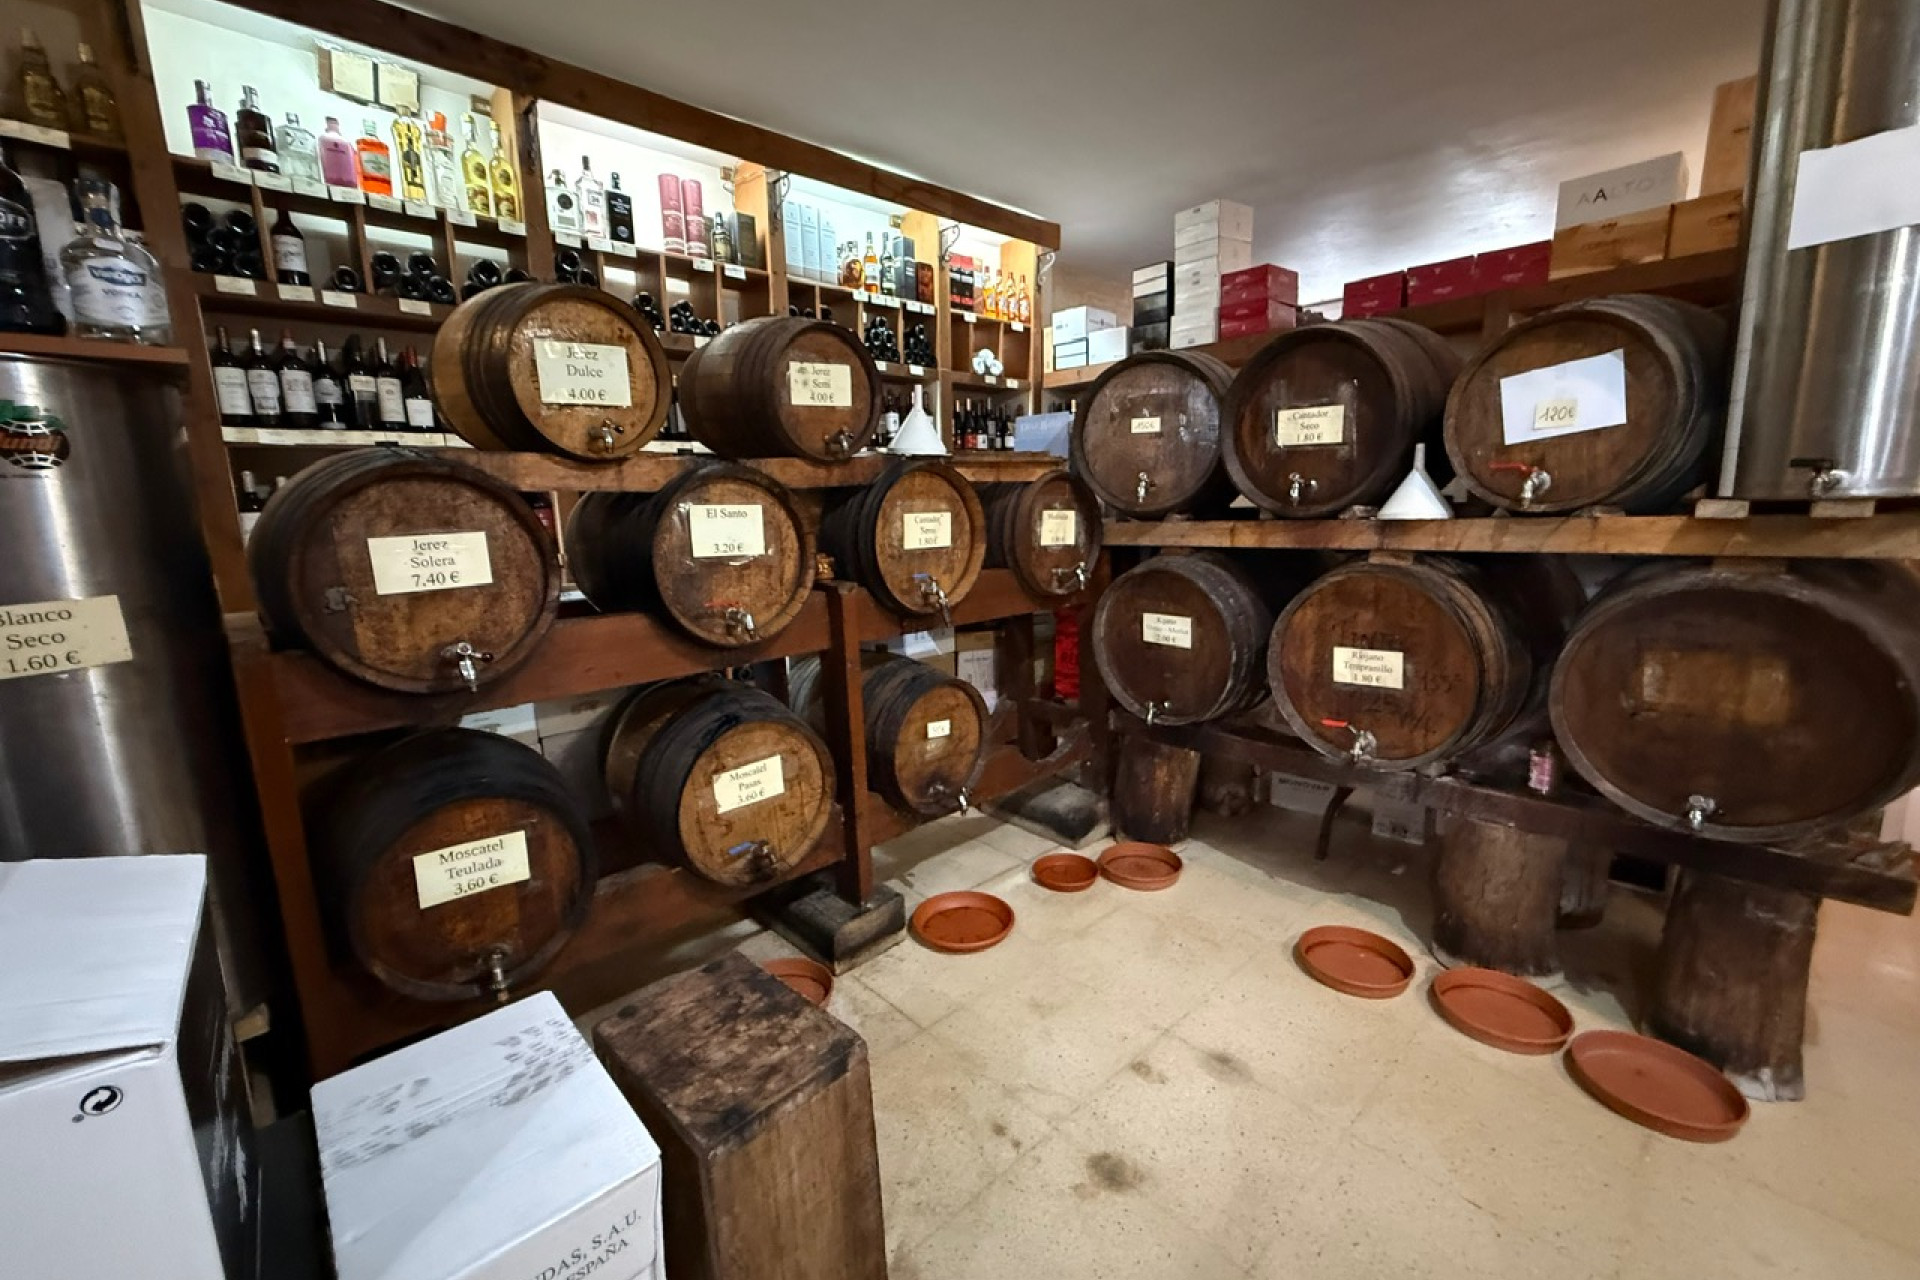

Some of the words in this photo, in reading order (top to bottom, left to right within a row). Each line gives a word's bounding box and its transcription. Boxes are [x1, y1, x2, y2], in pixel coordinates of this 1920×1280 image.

[567, 363, 604, 378] Dulce
[568, 388, 596, 400] 4.00
[598, 389, 606, 401] €
[1300, 421, 1319, 431] Seco
[706, 508, 717, 519] El
[720, 507, 748, 518] Santo
[412, 540, 448, 551] Jerez
[714, 543, 735, 554] 3.20
[737, 542, 745, 553] €
[410, 555, 456, 569] Solera
[411, 571, 446, 588] 7.40
[450, 570, 460, 584] €
[6, 632, 66, 650] Seco
[7, 653, 58, 674] 1.60
[65, 650, 82, 666] €
[438, 837, 505, 866] Moscatel
[445, 856, 503, 880] Teulada
[453, 876, 485, 896] 3.60
[488, 873, 499, 884] €
[592, 1209, 641, 1250] S.A.U.
